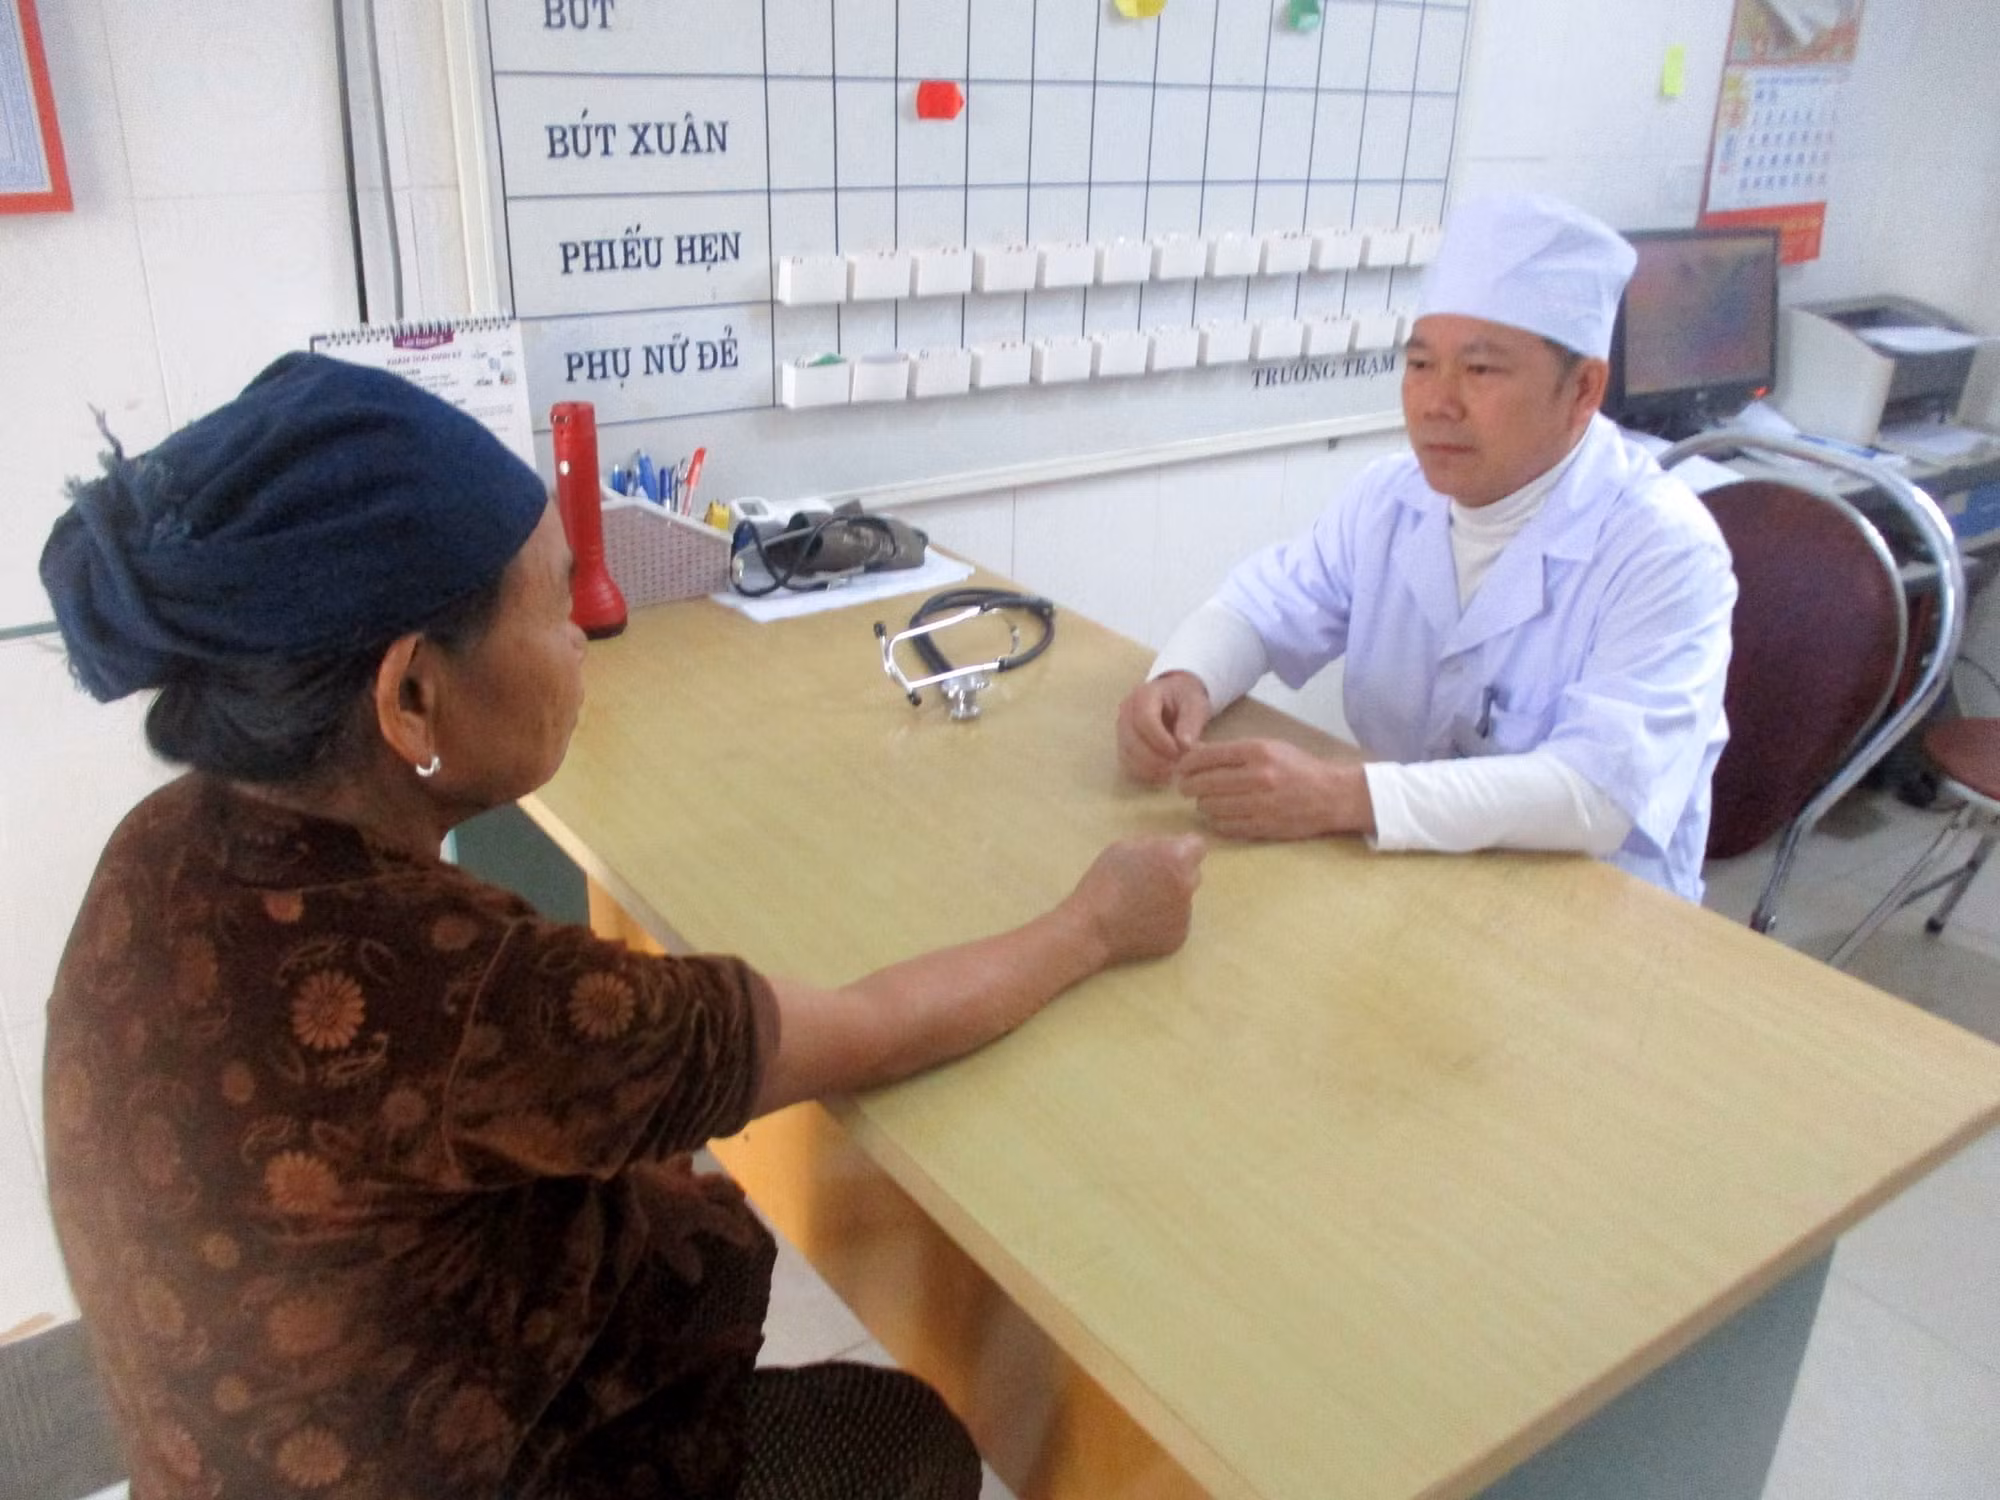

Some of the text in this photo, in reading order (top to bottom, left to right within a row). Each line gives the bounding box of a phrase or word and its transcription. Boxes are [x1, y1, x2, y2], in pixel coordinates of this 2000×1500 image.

[546, 109, 728, 158] BÚT XUÂN
[560, 225, 741, 274] PHIẾU HẸN
[565, 325, 739, 389] PHỤ NỮ ĐẺ
[1342, 354, 1396, 381] TRẠM
